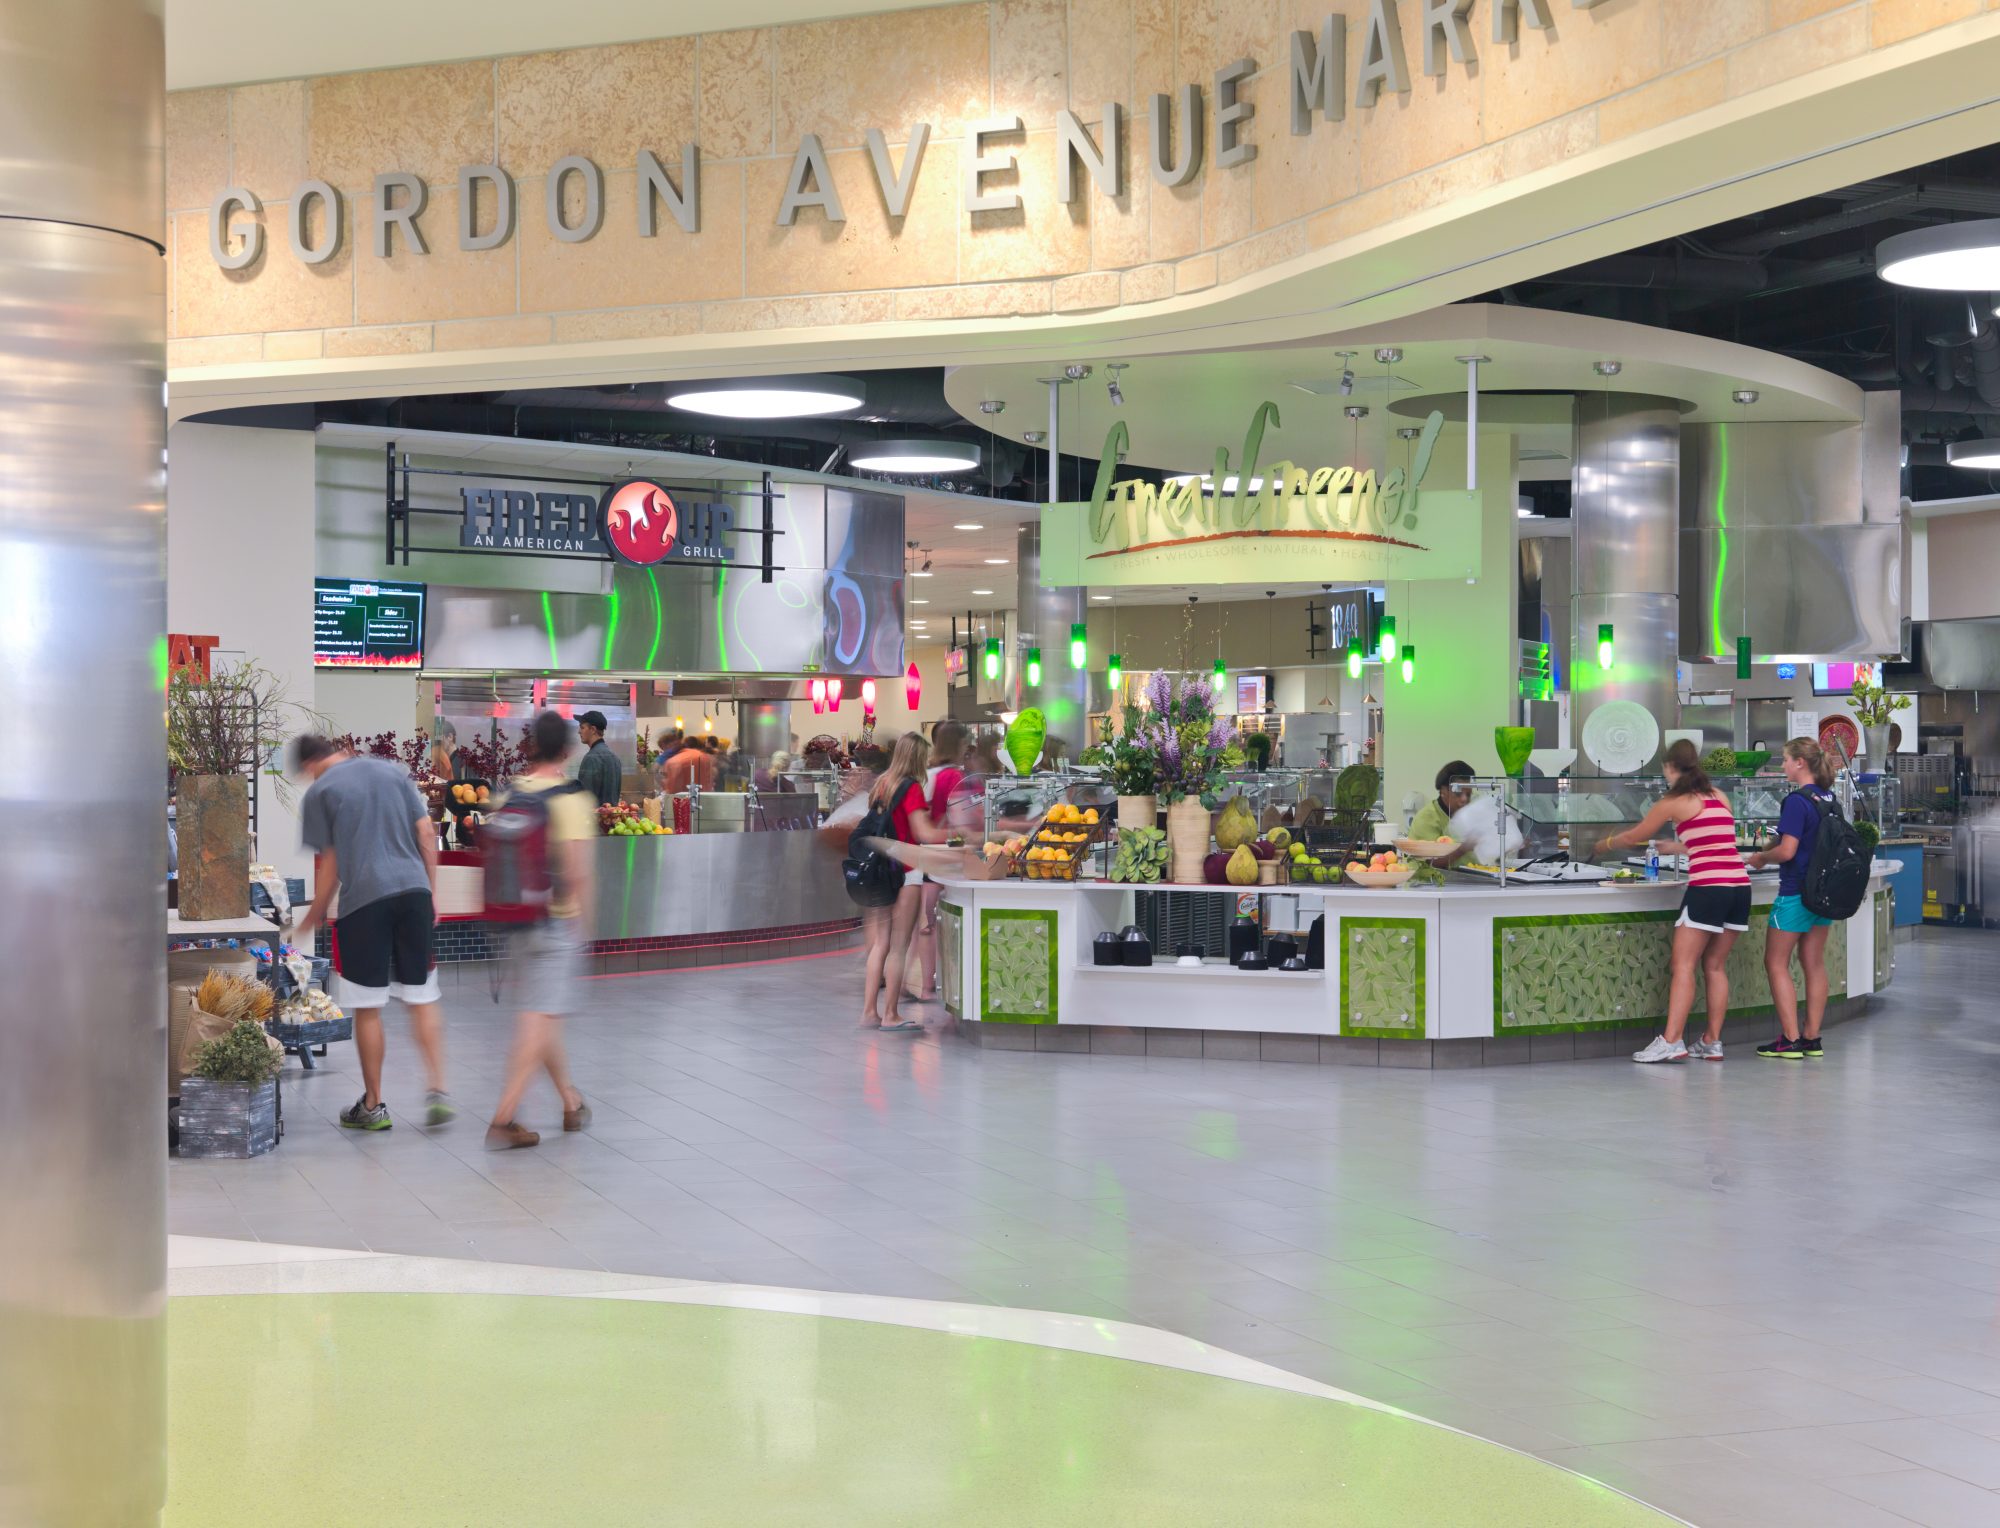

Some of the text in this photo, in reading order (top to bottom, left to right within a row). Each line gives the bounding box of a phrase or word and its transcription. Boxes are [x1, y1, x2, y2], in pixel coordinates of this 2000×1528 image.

[208, 0, 1602, 271] GORDON AVENUE MAR
[1088, 419, 1236, 550] Great
[460, 487, 735, 548] FIRED UP
[474, 534, 725, 559] AN AMERICAN GRILL
[1112, 544, 1401, 571] FRESH WHOLESOME NATURAL HEALTHY
[1330, 603, 1358, 650] 1849
